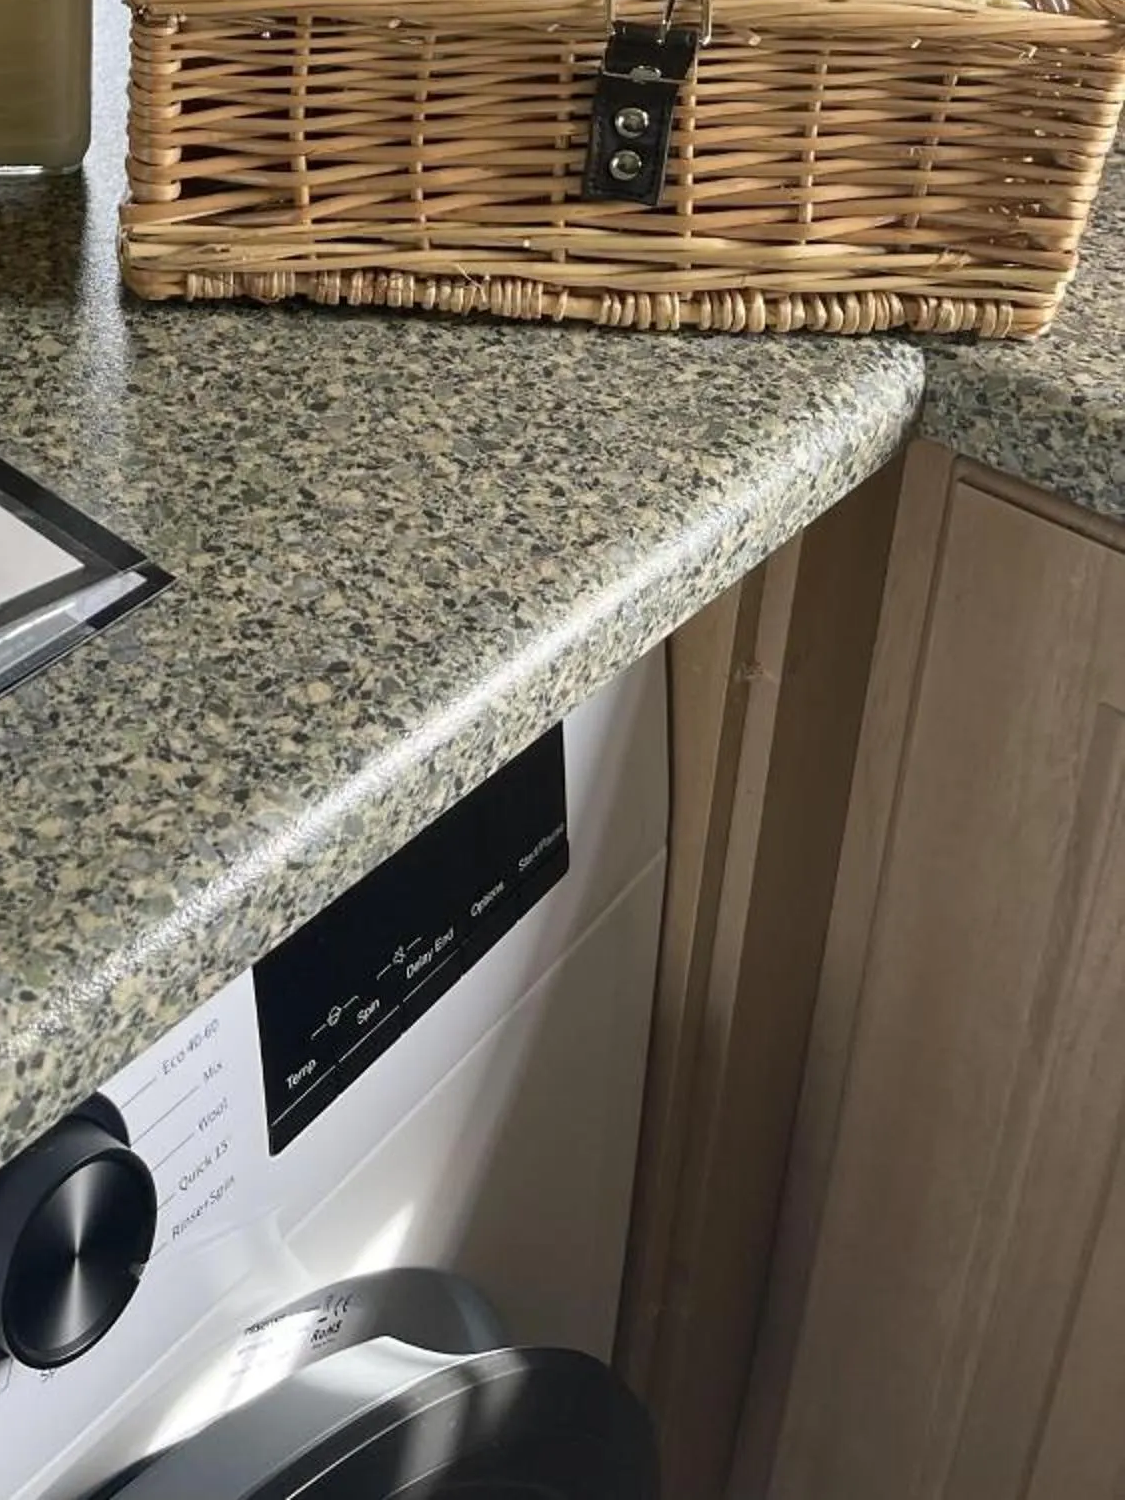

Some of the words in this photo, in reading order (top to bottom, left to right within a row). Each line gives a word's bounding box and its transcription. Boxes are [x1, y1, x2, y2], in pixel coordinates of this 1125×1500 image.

[405, 947, 434, 981] Delay
[433, 926, 456, 954] End
[356, 997, 381, 1027] Spin
[161, 1048, 186, 1077] Eco
[285, 1057, 317, 1092] Temp
[177, 1154, 213, 1193] Quick
